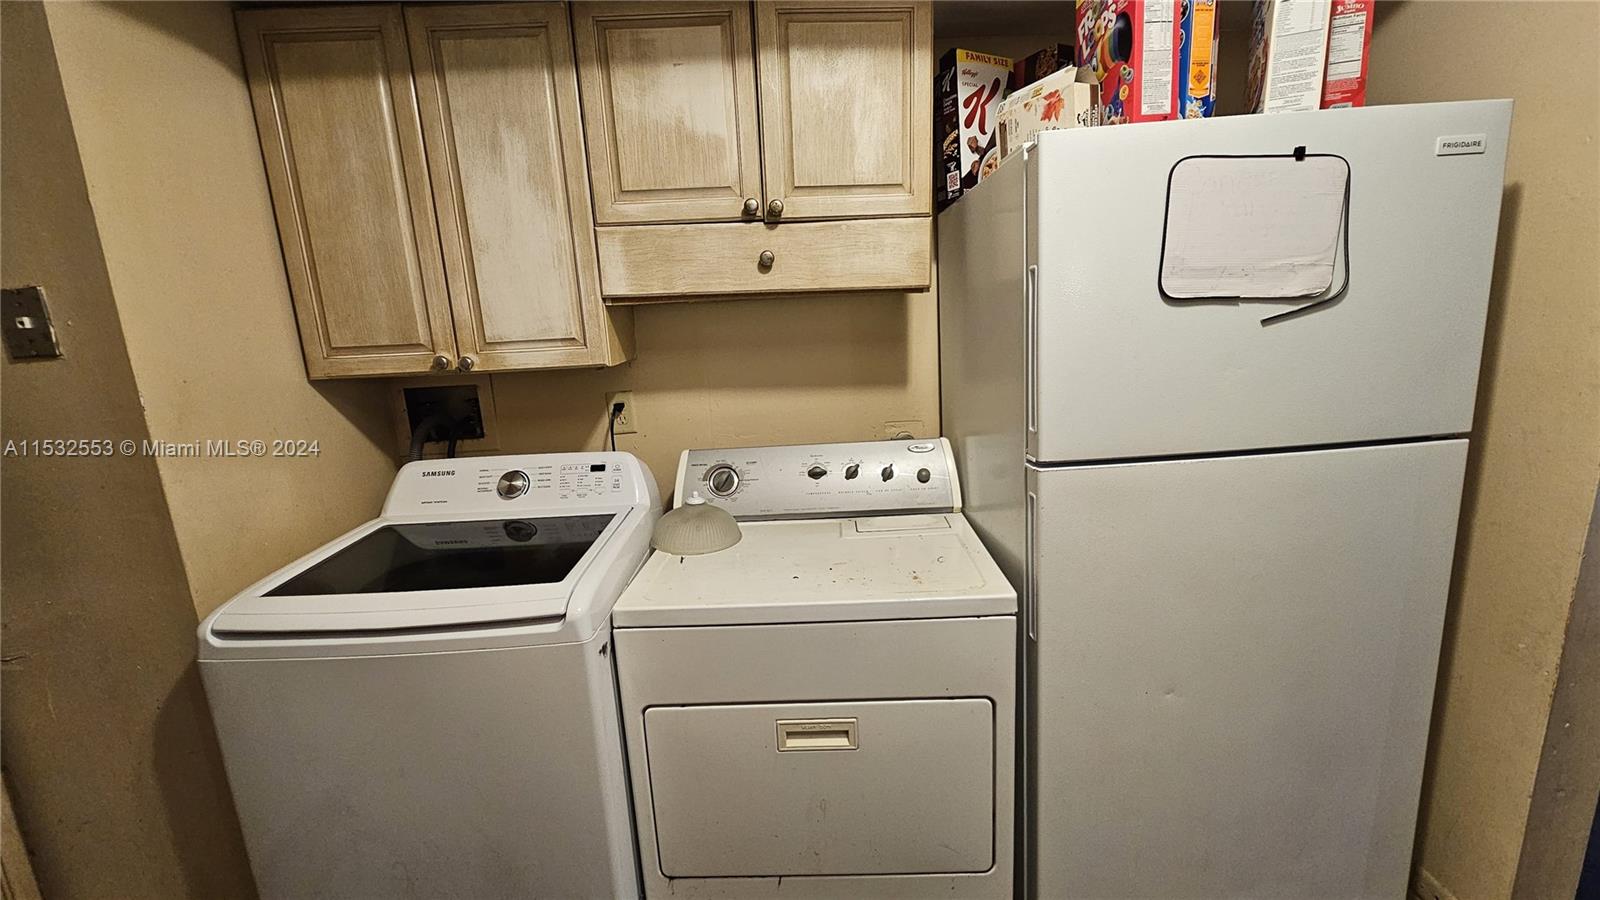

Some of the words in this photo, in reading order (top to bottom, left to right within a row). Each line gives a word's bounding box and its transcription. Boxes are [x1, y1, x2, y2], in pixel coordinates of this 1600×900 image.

[965, 52, 991, 64] FAMILY
[993, 57, 1009, 67] SIZE
[963, 77, 1000, 136] K
[1442, 140, 1482, 149] FRIGIDAIRE
[421, 470, 456, 478] SAMSUNG
